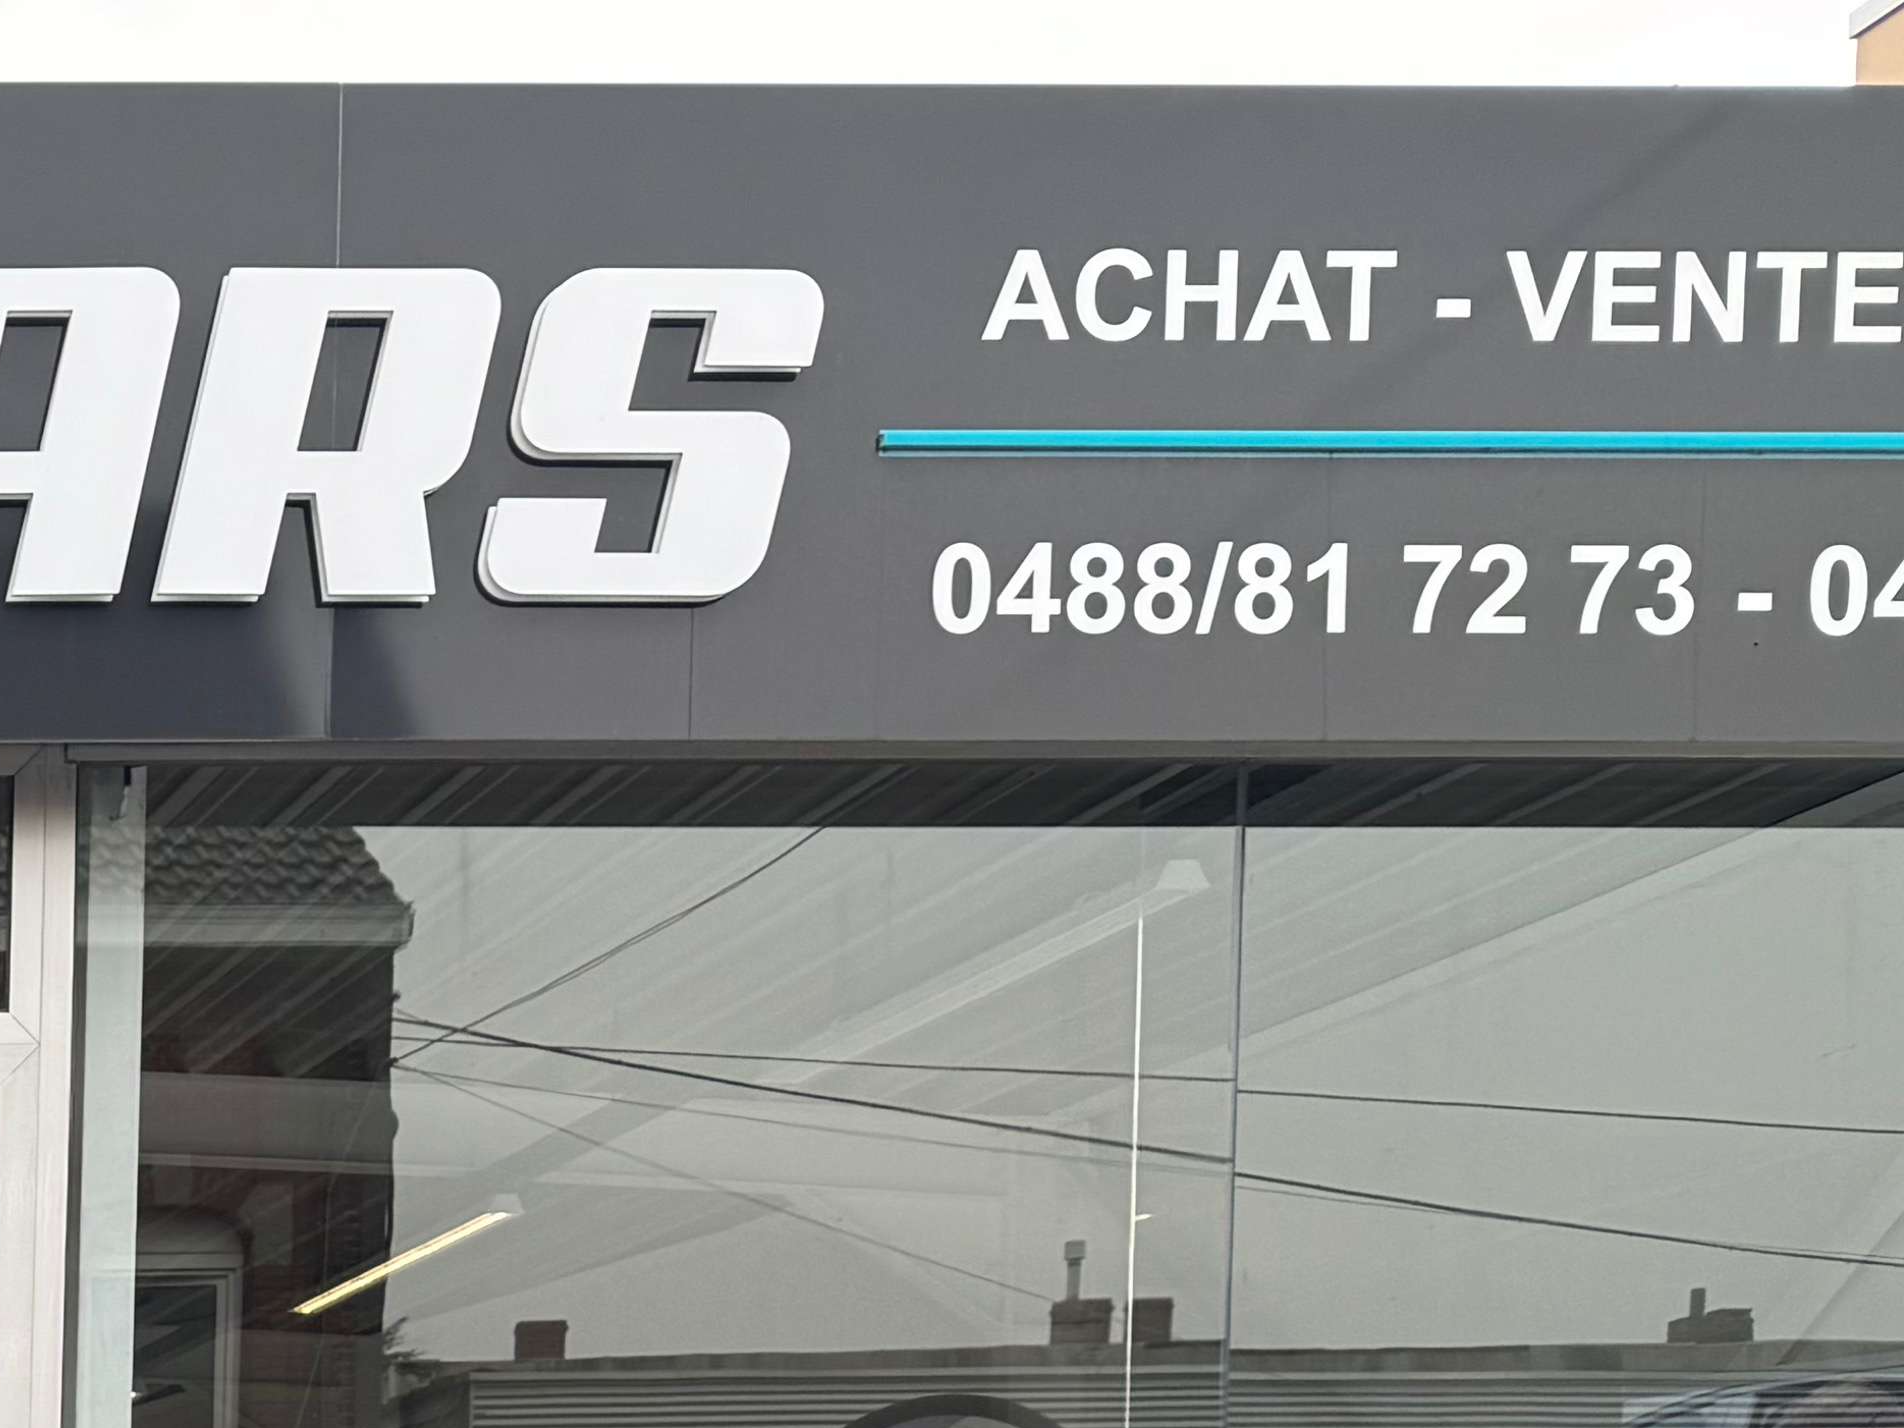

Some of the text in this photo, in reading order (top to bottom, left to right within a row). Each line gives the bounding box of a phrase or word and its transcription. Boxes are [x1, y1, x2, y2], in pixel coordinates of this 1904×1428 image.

[981, 248, 1398, 342] ACHAT
[1506, 250, 1904, 344] VENTE
[931, 541, 1349, 636] 0488/81
[1402, 544, 1530, 636] 72
[1570, 544, 1696, 637] 73
